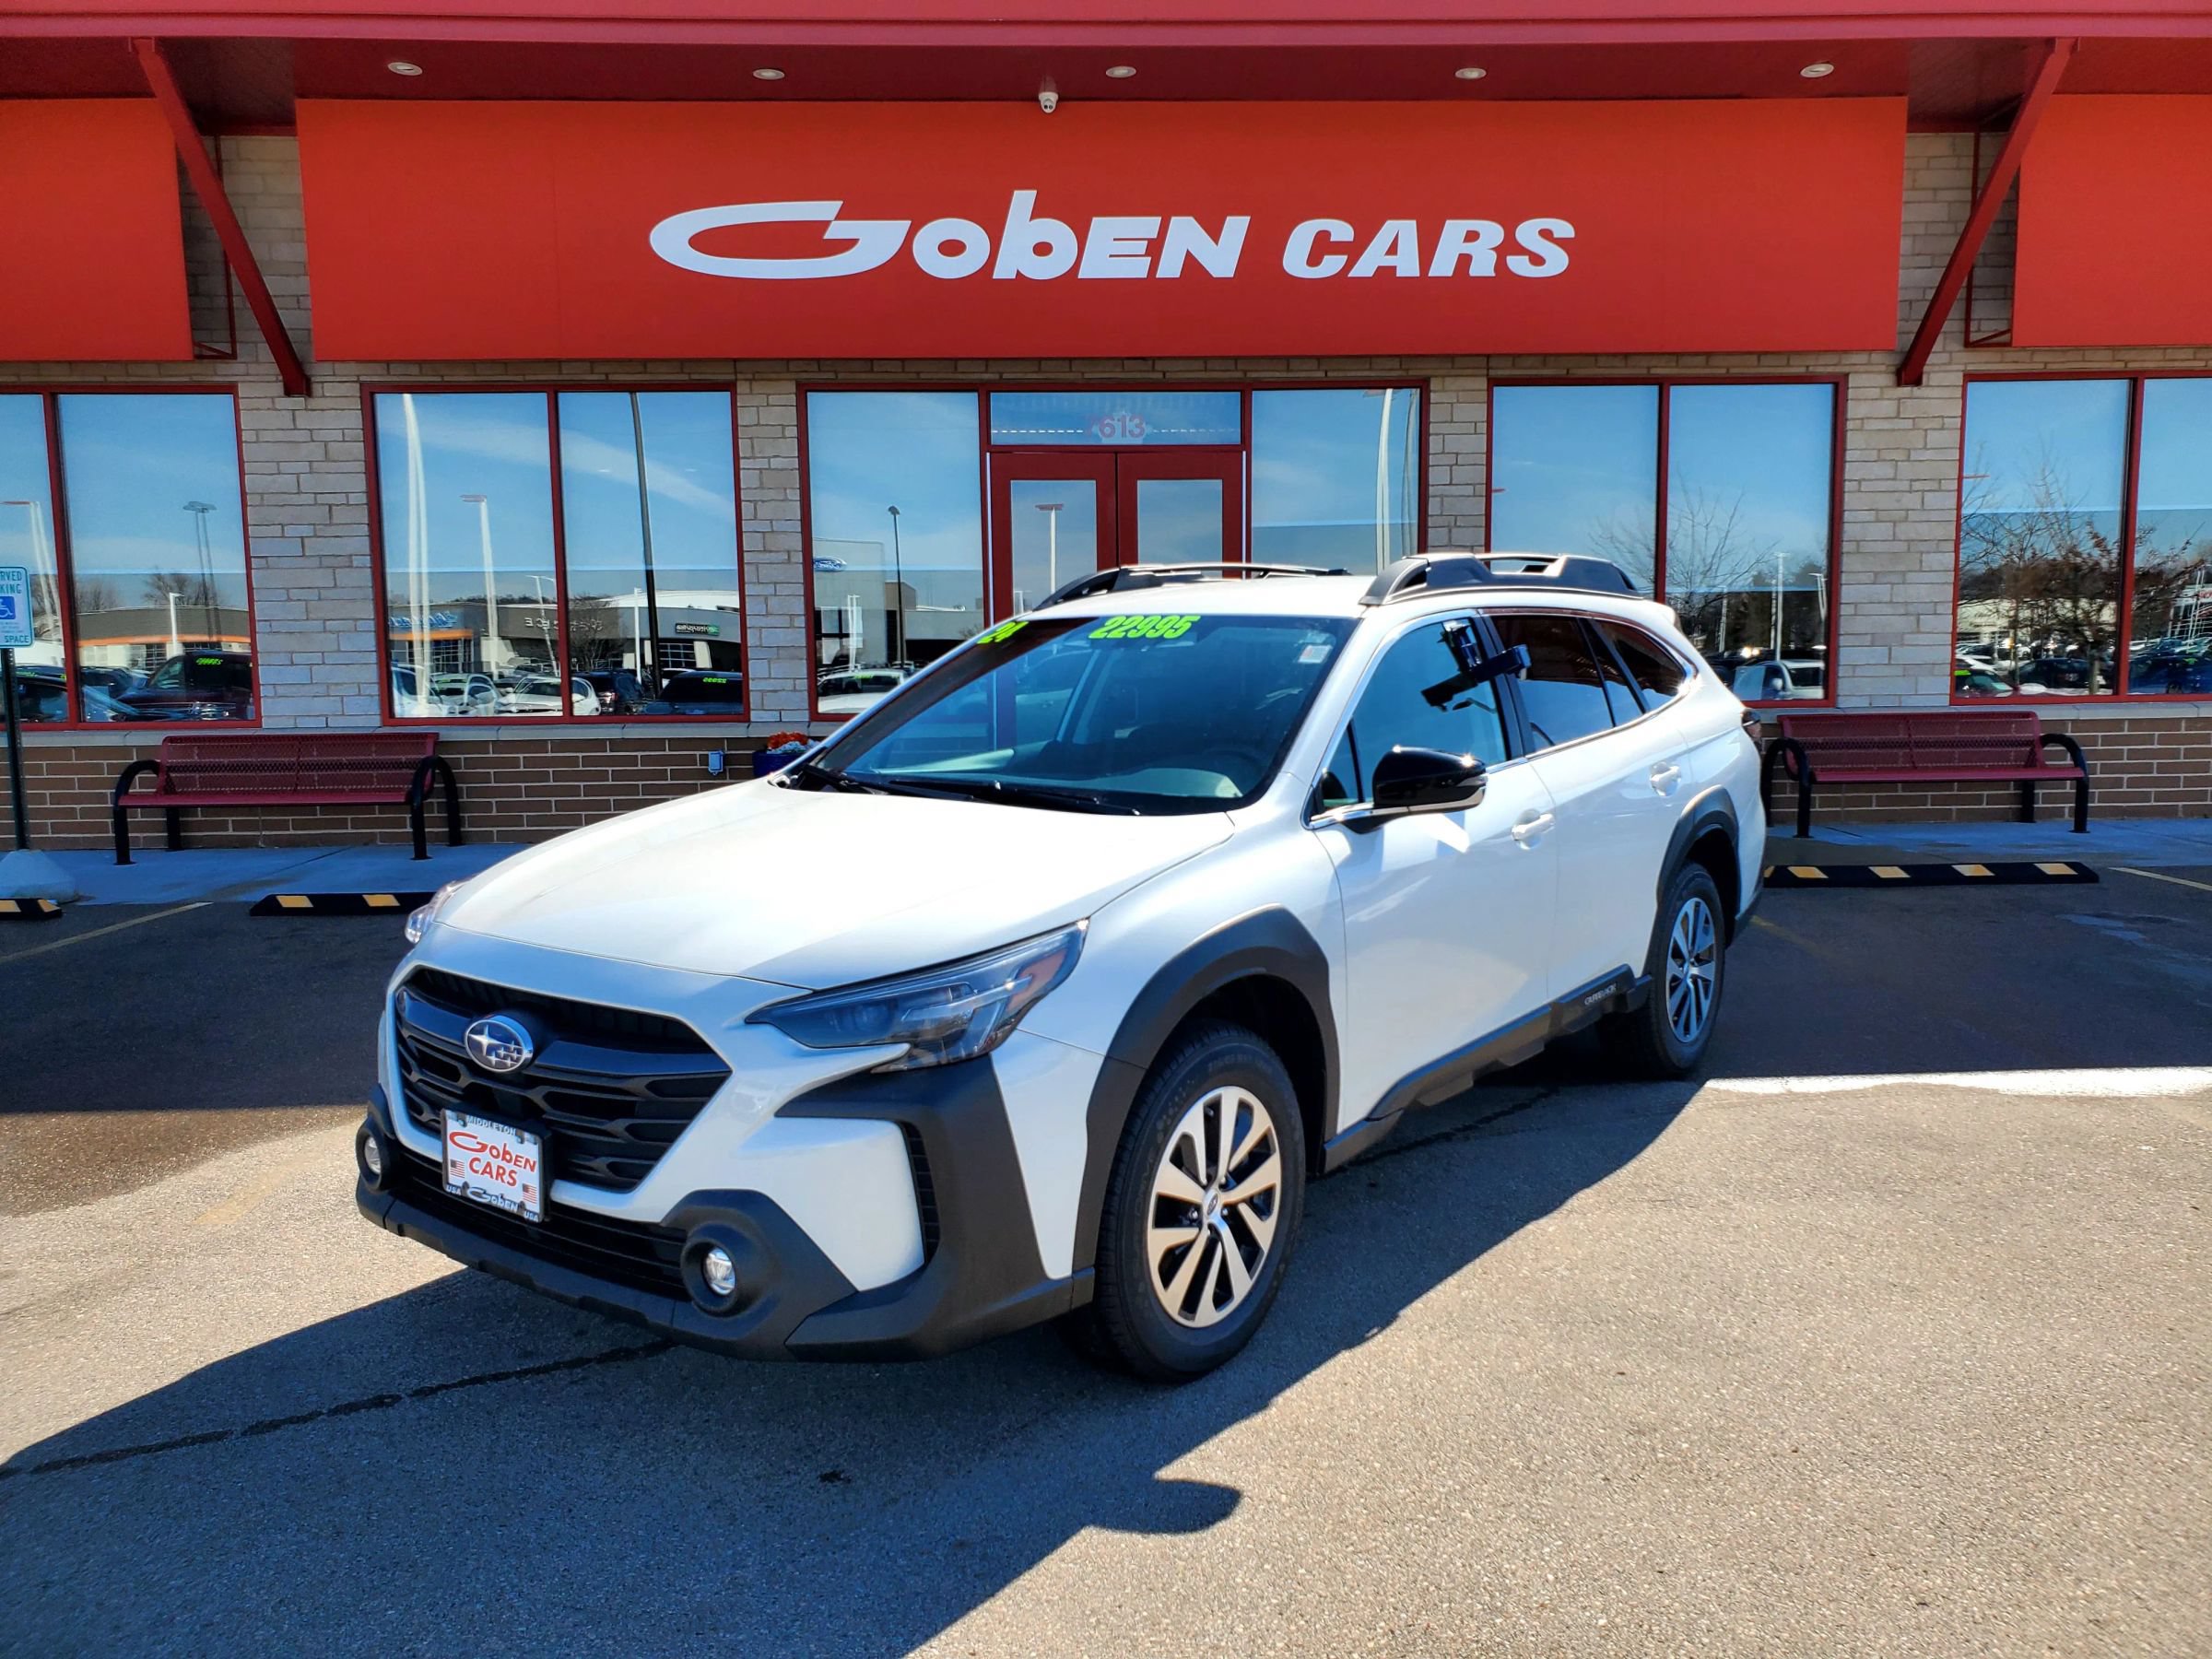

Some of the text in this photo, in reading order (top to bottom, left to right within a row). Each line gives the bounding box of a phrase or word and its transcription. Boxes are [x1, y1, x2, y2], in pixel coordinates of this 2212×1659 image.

[1283, 218, 1574, 278] CARS
[4, 635, 29, 643] SPACE
[1088, 615, 1201, 639] 22995
[468, 1157, 517, 1187] CARS
[446, 1184, 462, 1195] USA
[524, 1209, 538, 1223] USA
